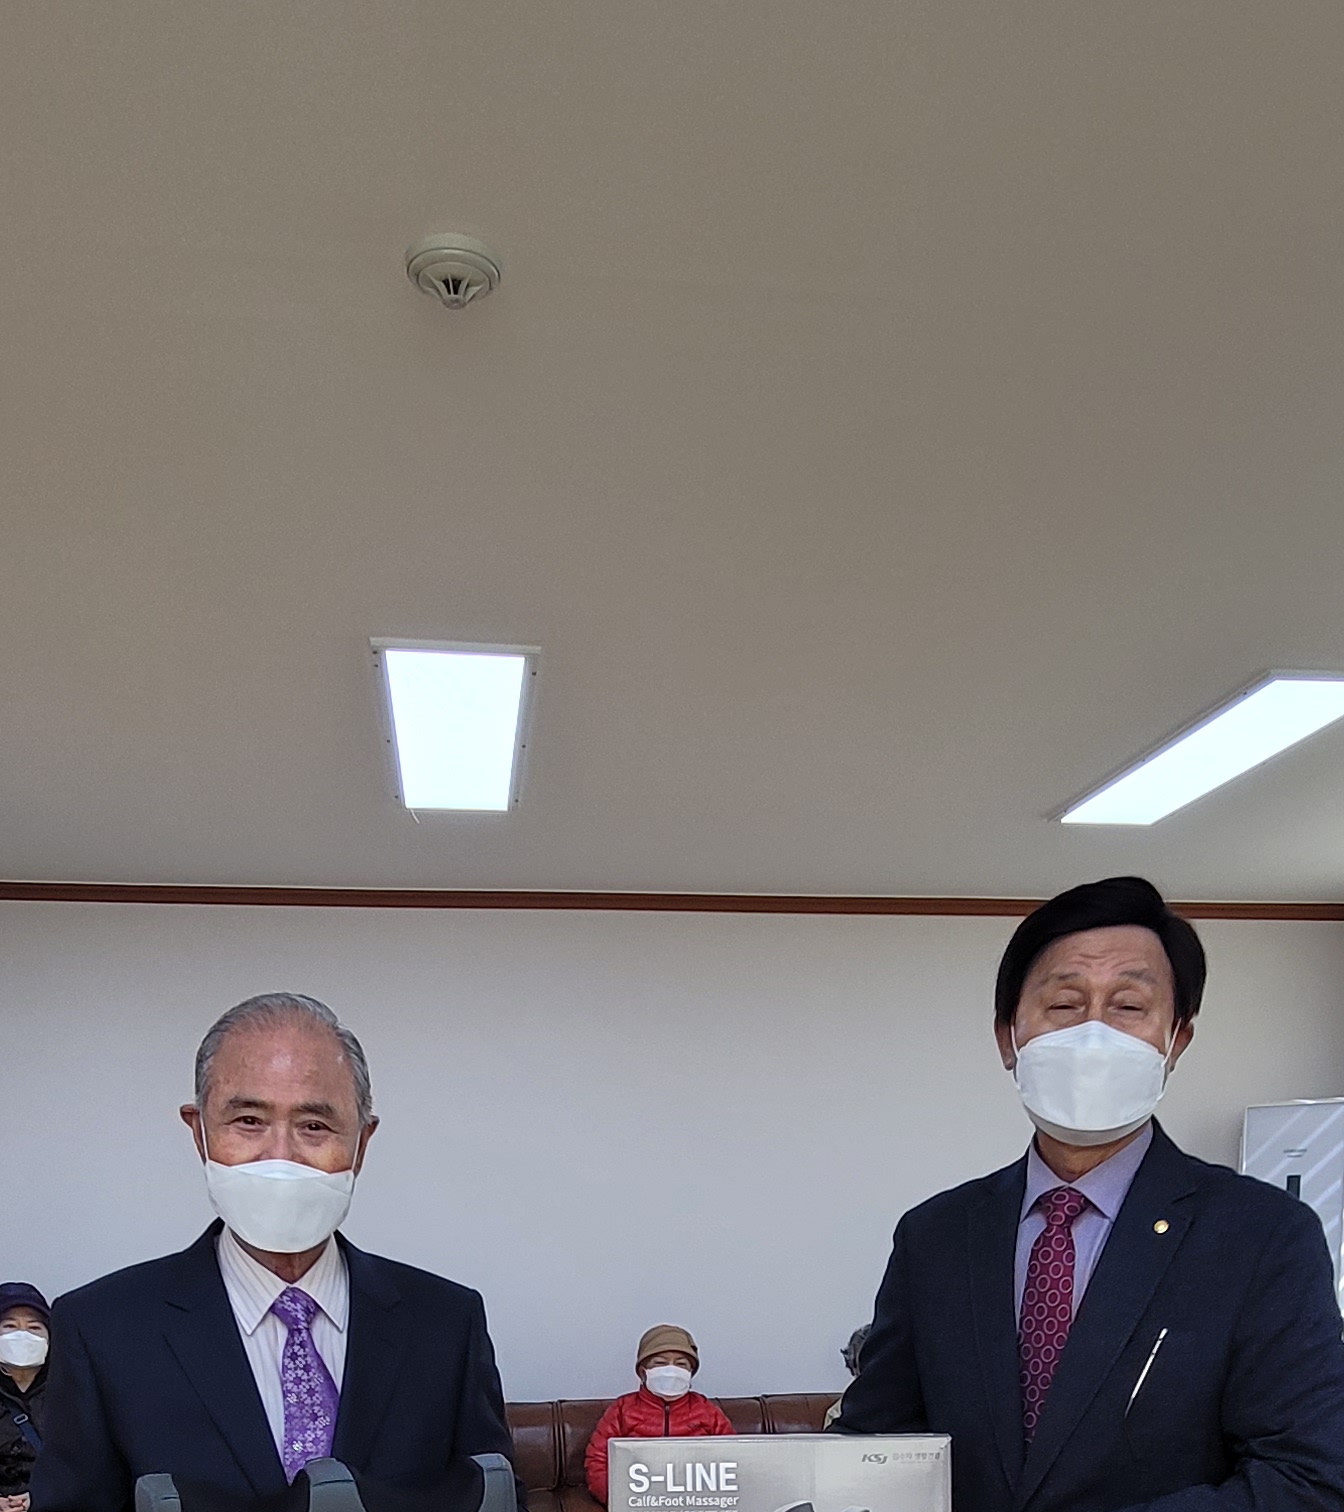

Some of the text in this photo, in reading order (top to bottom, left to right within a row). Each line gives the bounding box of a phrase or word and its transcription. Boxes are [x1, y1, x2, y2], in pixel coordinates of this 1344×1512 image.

[861, 1453, 888, 1464] KSJ
[629, 1462, 739, 1493] S-LINE
[628, 1496, 740, 1508] Calf&Foot Massager
